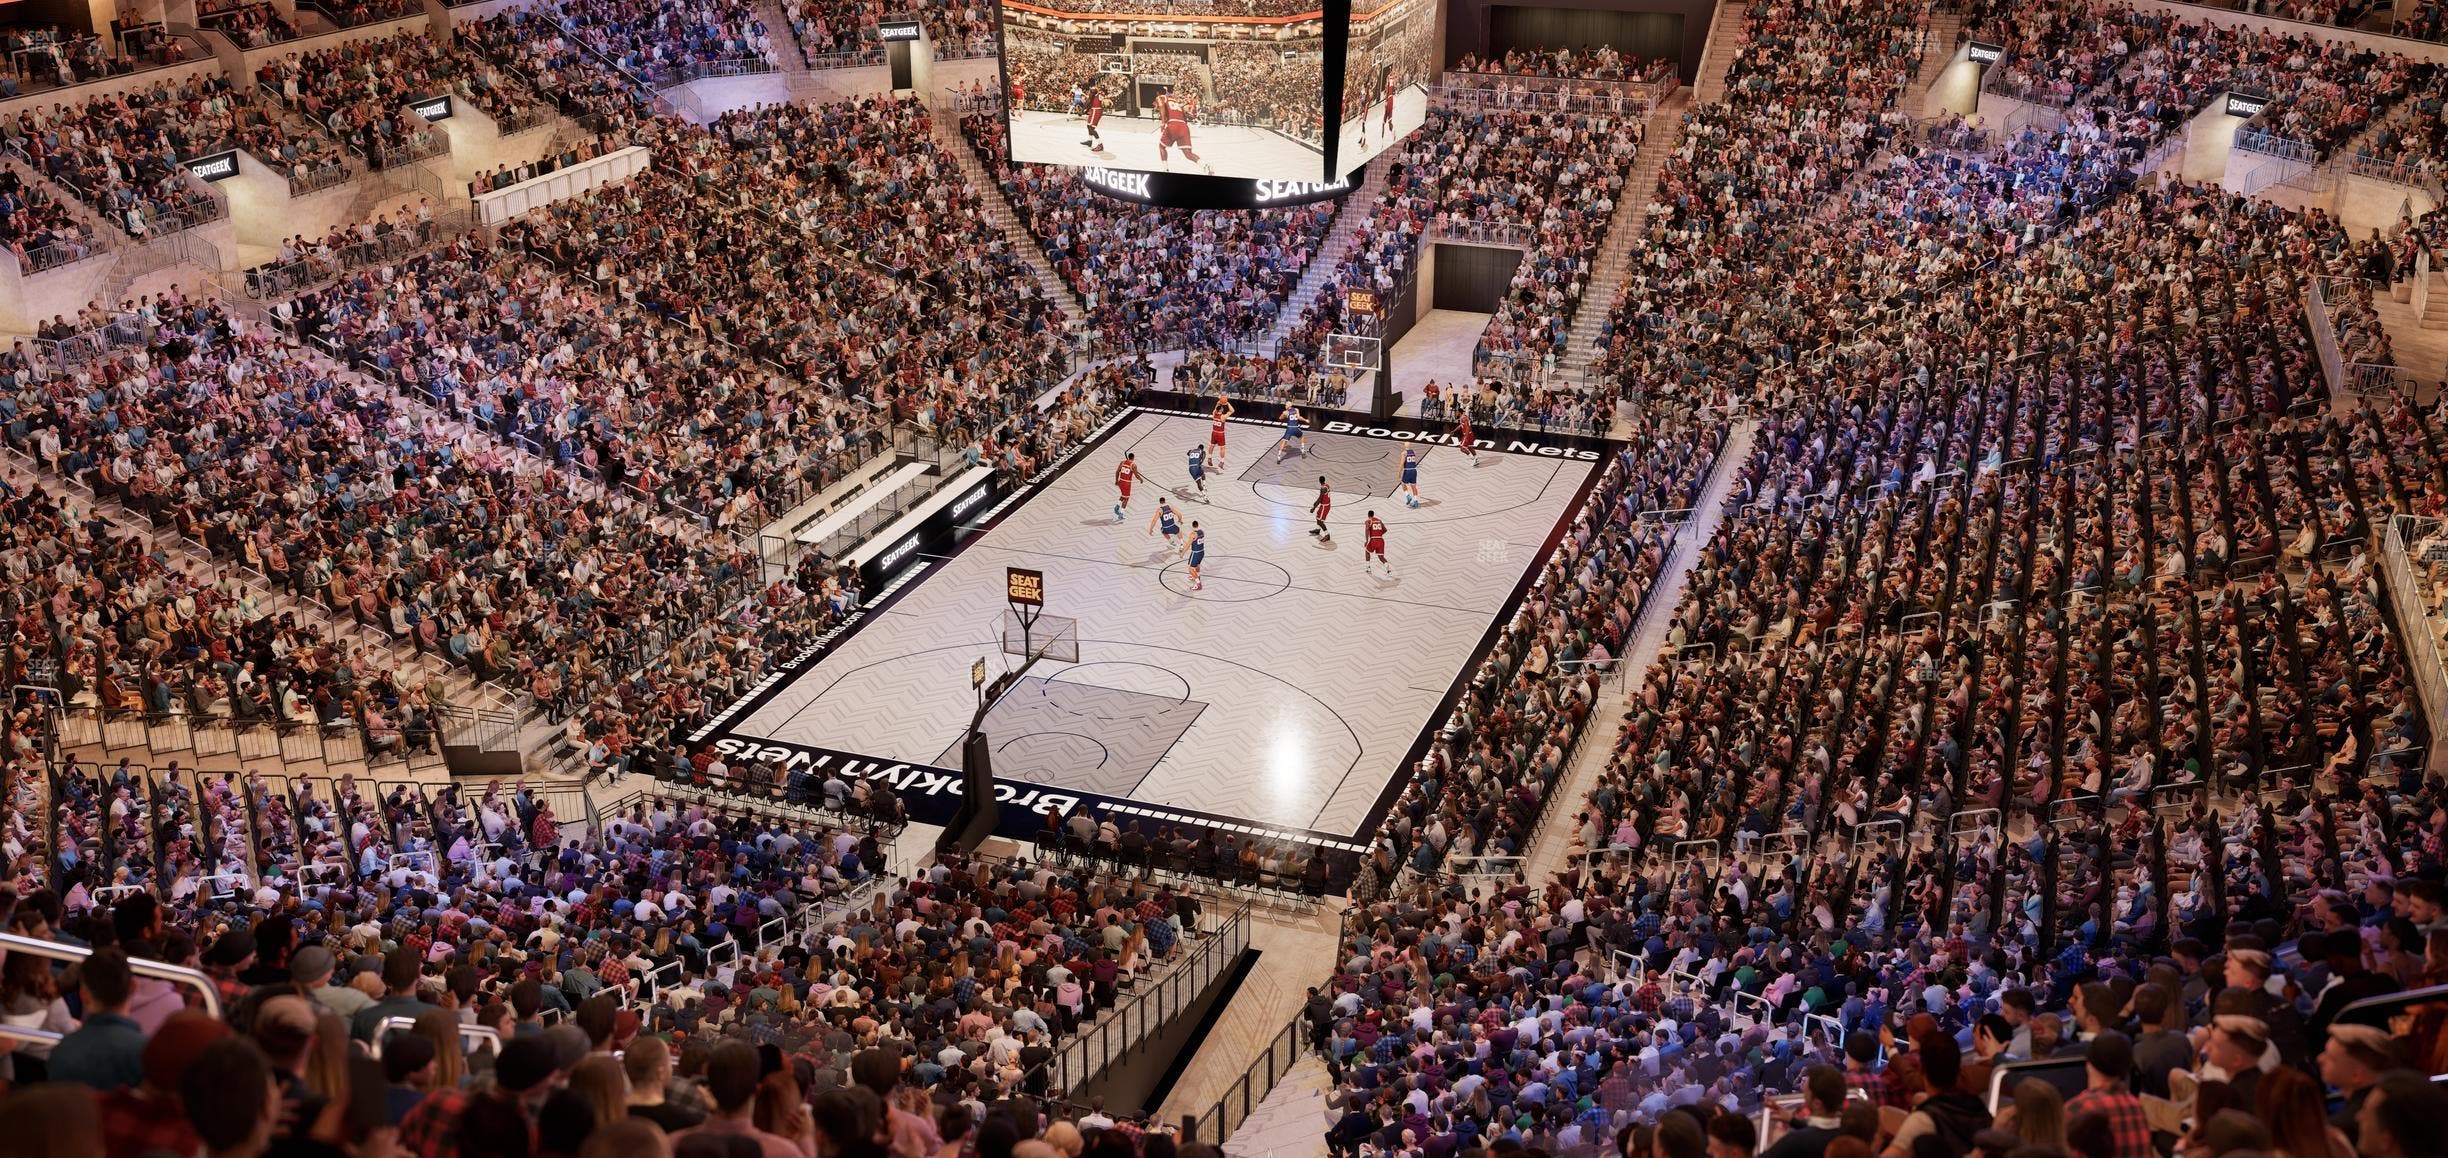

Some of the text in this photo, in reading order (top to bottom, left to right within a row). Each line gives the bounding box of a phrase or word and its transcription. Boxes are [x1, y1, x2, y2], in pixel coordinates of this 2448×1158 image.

[881, 26, 918, 37] SEATGEEK
[2228, 99, 2263, 113] SEATGEE
[193, 157, 231, 177] SEATGEEK
[1350, 292, 1373, 302] SEAT
[1350, 302, 1374, 311] GEEK
[1322, 420, 1600, 461] Brooklyn Nets
[953, 484, 987, 518] SEATGEEK
[882, 533, 920, 571] SEATGEEK
[1010, 573, 1041, 588] SEAT
[1009, 585, 1042, 601] GEEK
